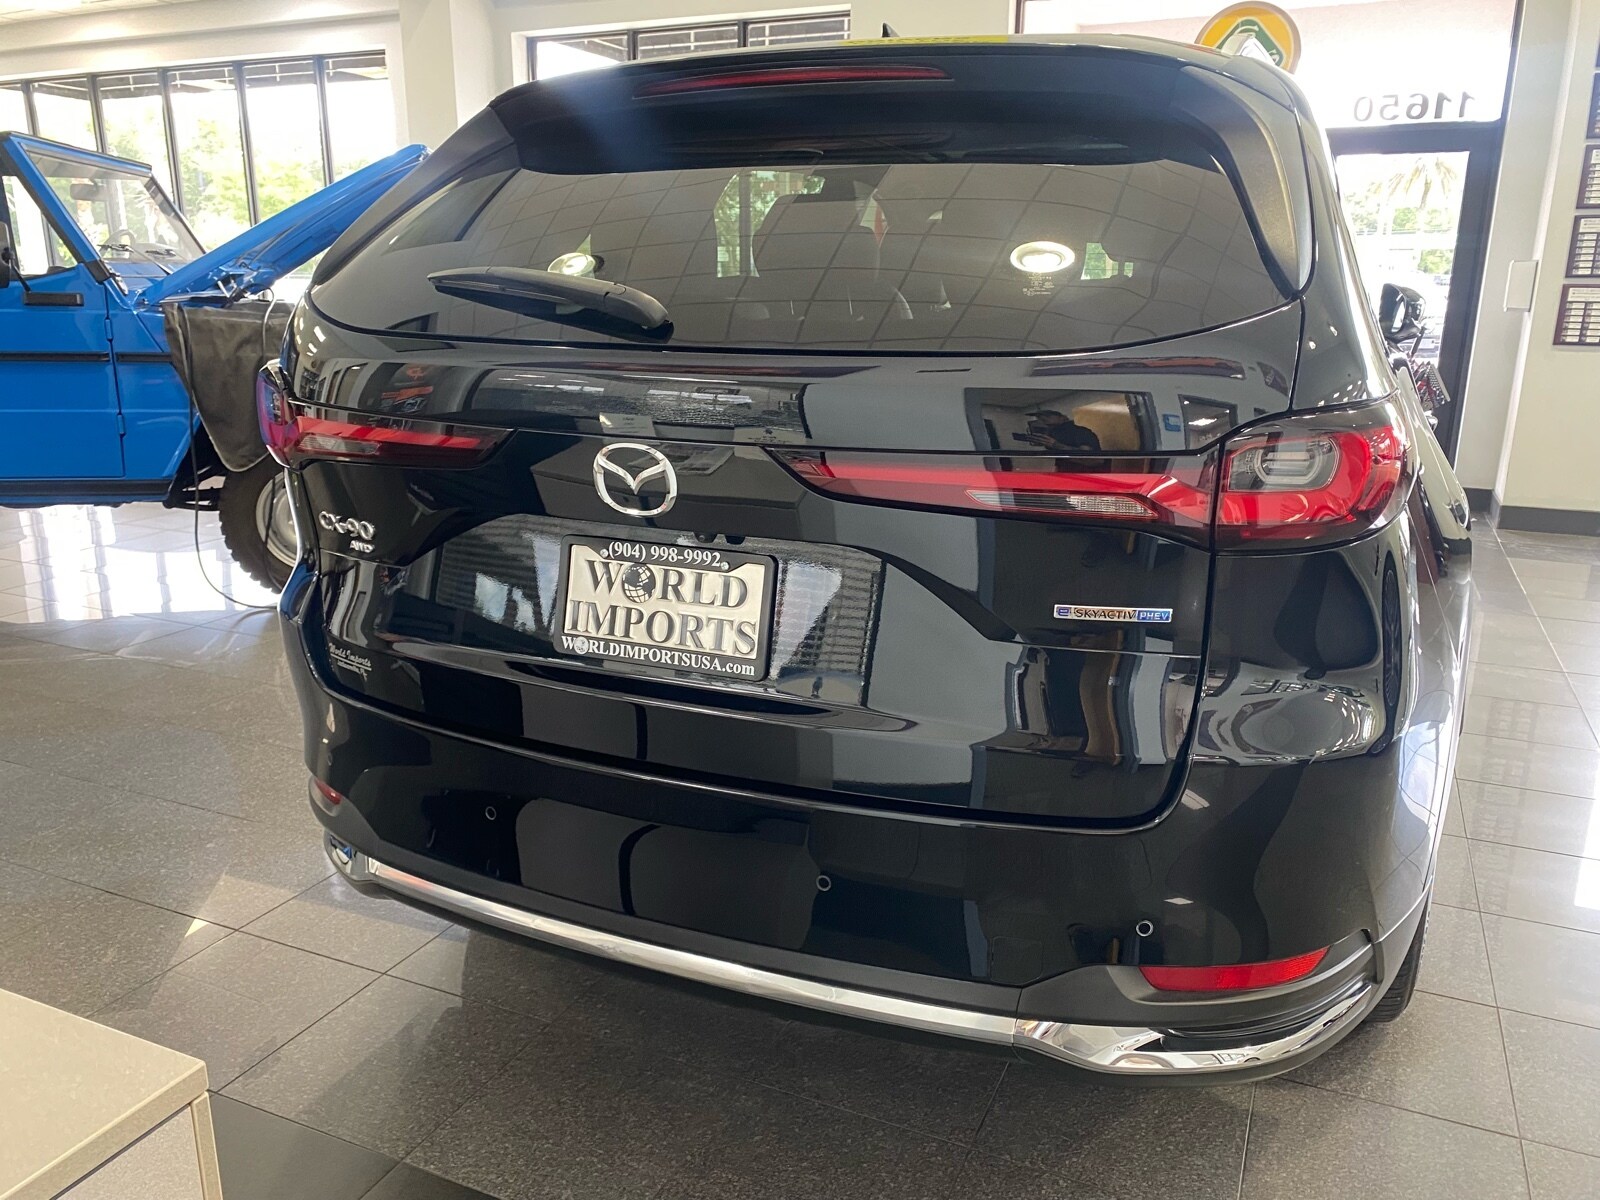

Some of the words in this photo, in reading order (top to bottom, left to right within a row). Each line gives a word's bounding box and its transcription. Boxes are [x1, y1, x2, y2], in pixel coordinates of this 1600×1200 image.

[318, 510, 375, 540] CX-90
[608, 541, 646, 562] (904)
[650, 545, 721, 568] 998-9992
[585, 559, 749, 609] WORLD
[567, 600, 757, 656] IMPORTS
[1139, 611, 1169, 620] PHEV
